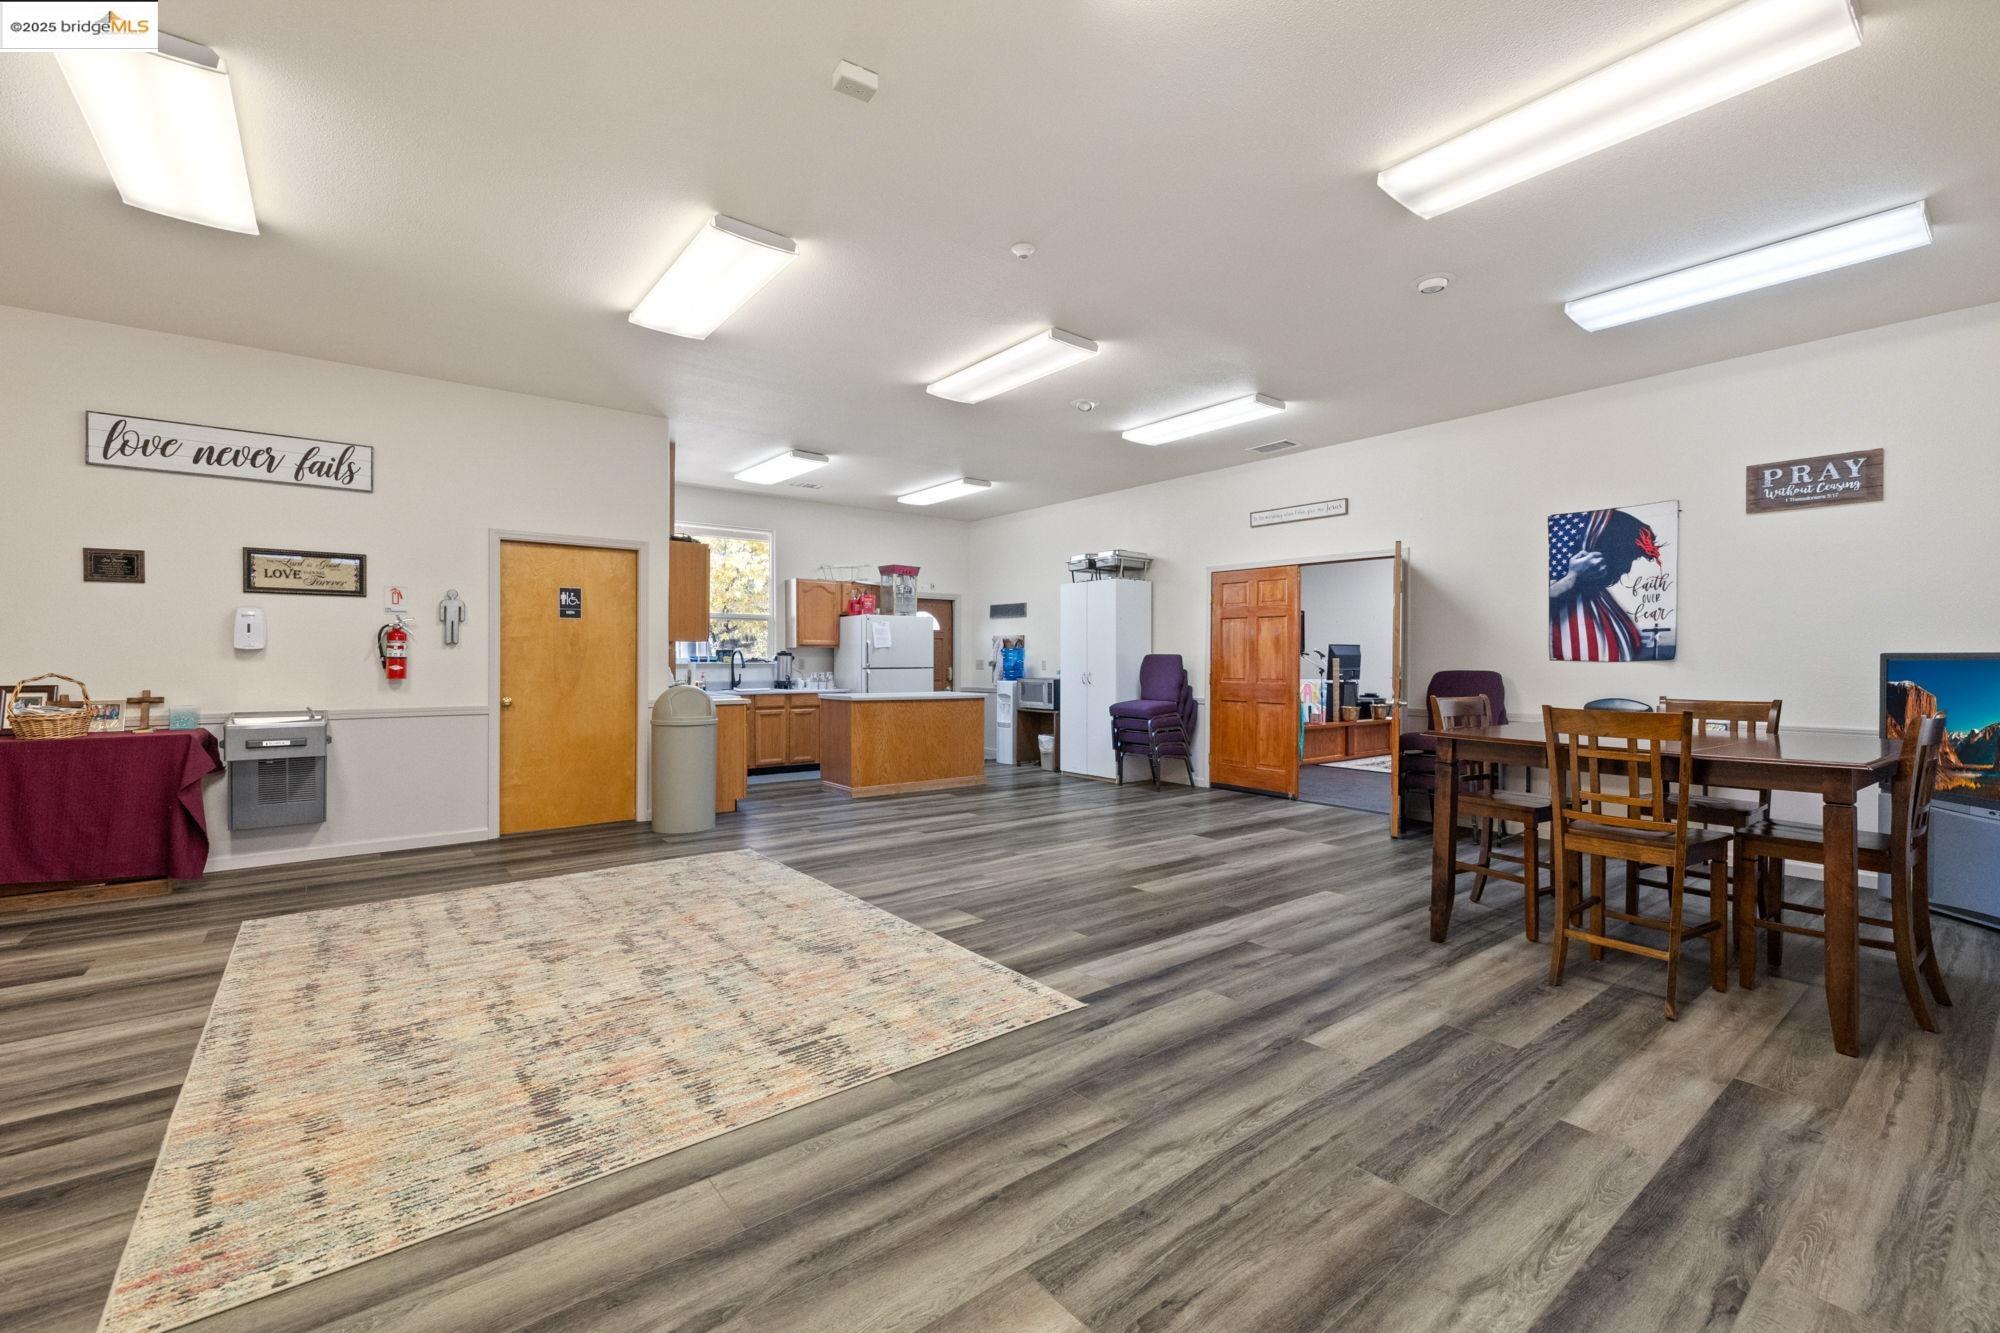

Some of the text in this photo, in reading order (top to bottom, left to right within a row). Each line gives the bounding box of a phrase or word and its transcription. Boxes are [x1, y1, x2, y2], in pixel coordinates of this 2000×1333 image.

[102, 419, 362, 486] love never fails
[1762, 457, 1868, 488] PRAY
[1764, 480, 1862, 499] Without Ceasing
[264, 568, 302, 580] LOVE
[1626, 573, 1673, 597] faith
[1642, 593, 1661, 604] OVER
[1626, 603, 1674, 624] fear
